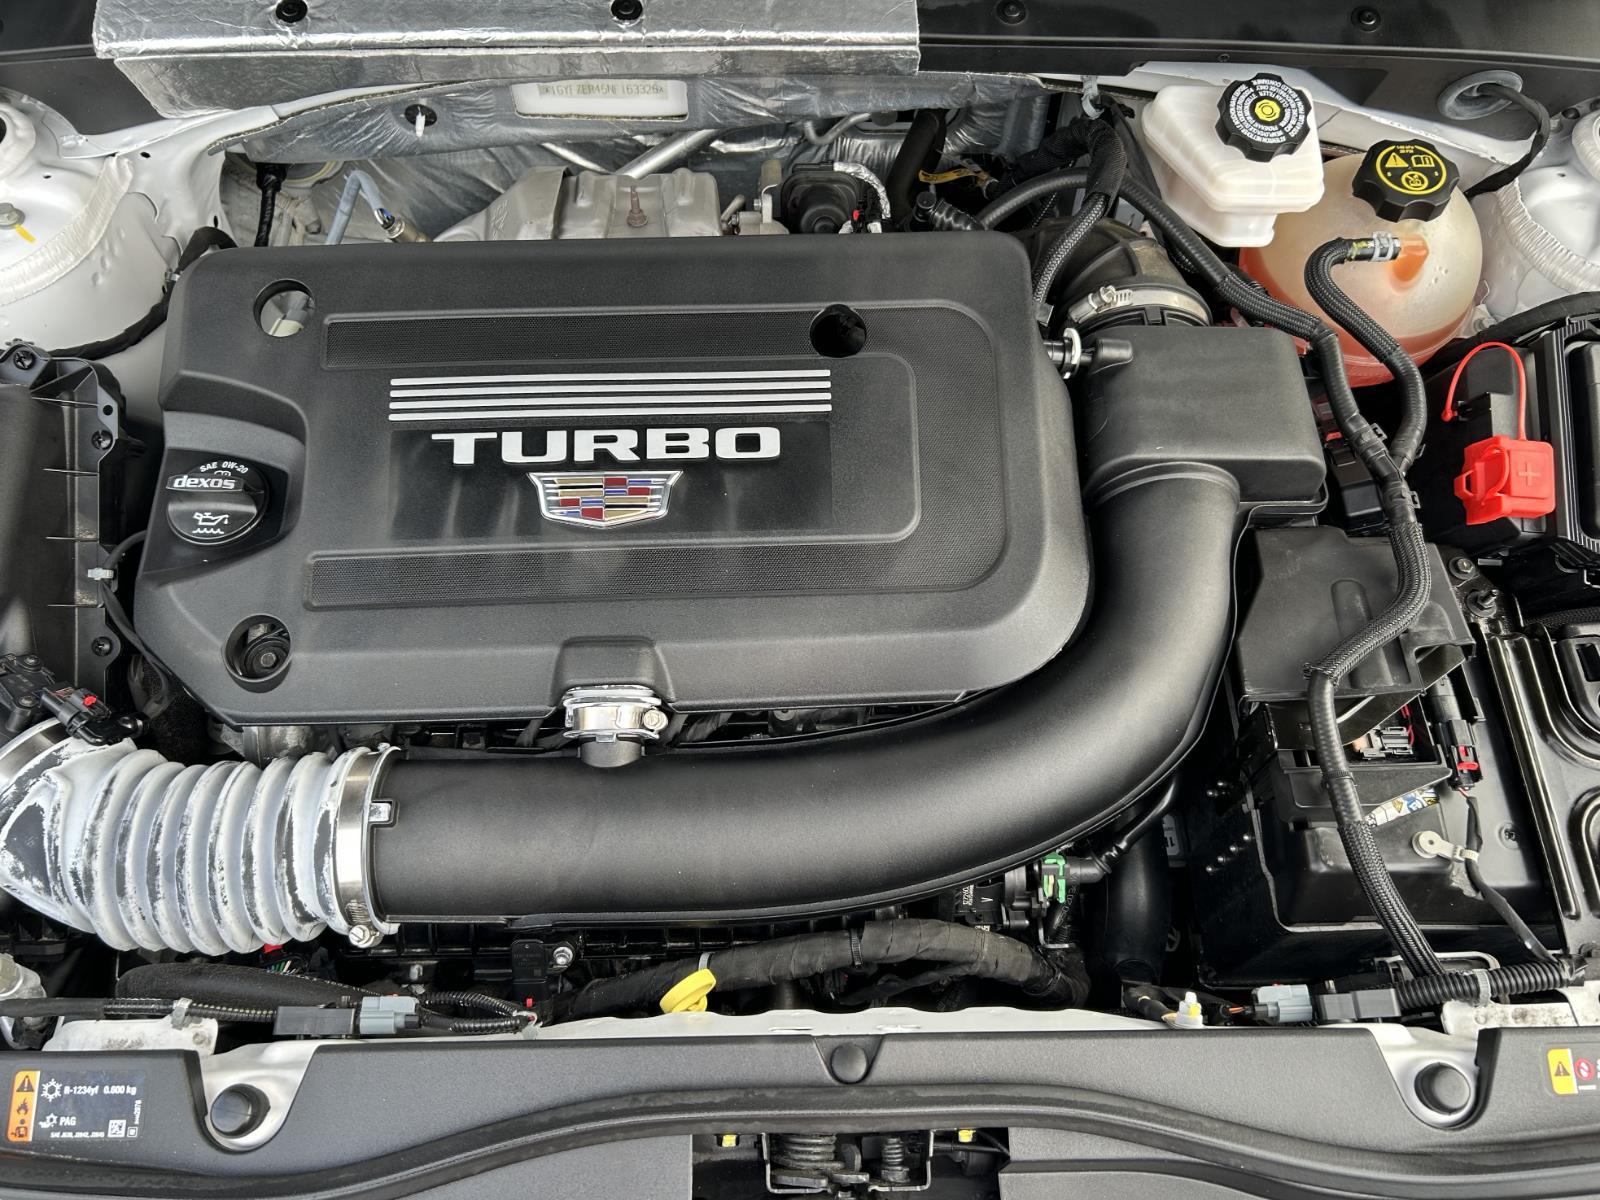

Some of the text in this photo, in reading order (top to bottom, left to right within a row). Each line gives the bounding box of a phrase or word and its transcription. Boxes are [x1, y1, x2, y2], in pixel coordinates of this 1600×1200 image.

[431, 426, 781, 465] TURBO
[199, 461, 249, 474] SAE 0W-20
[173, 474, 236, 490] dexos
[126, 1085, 137, 1096] kg
[59, 1116, 77, 1126] PAG
